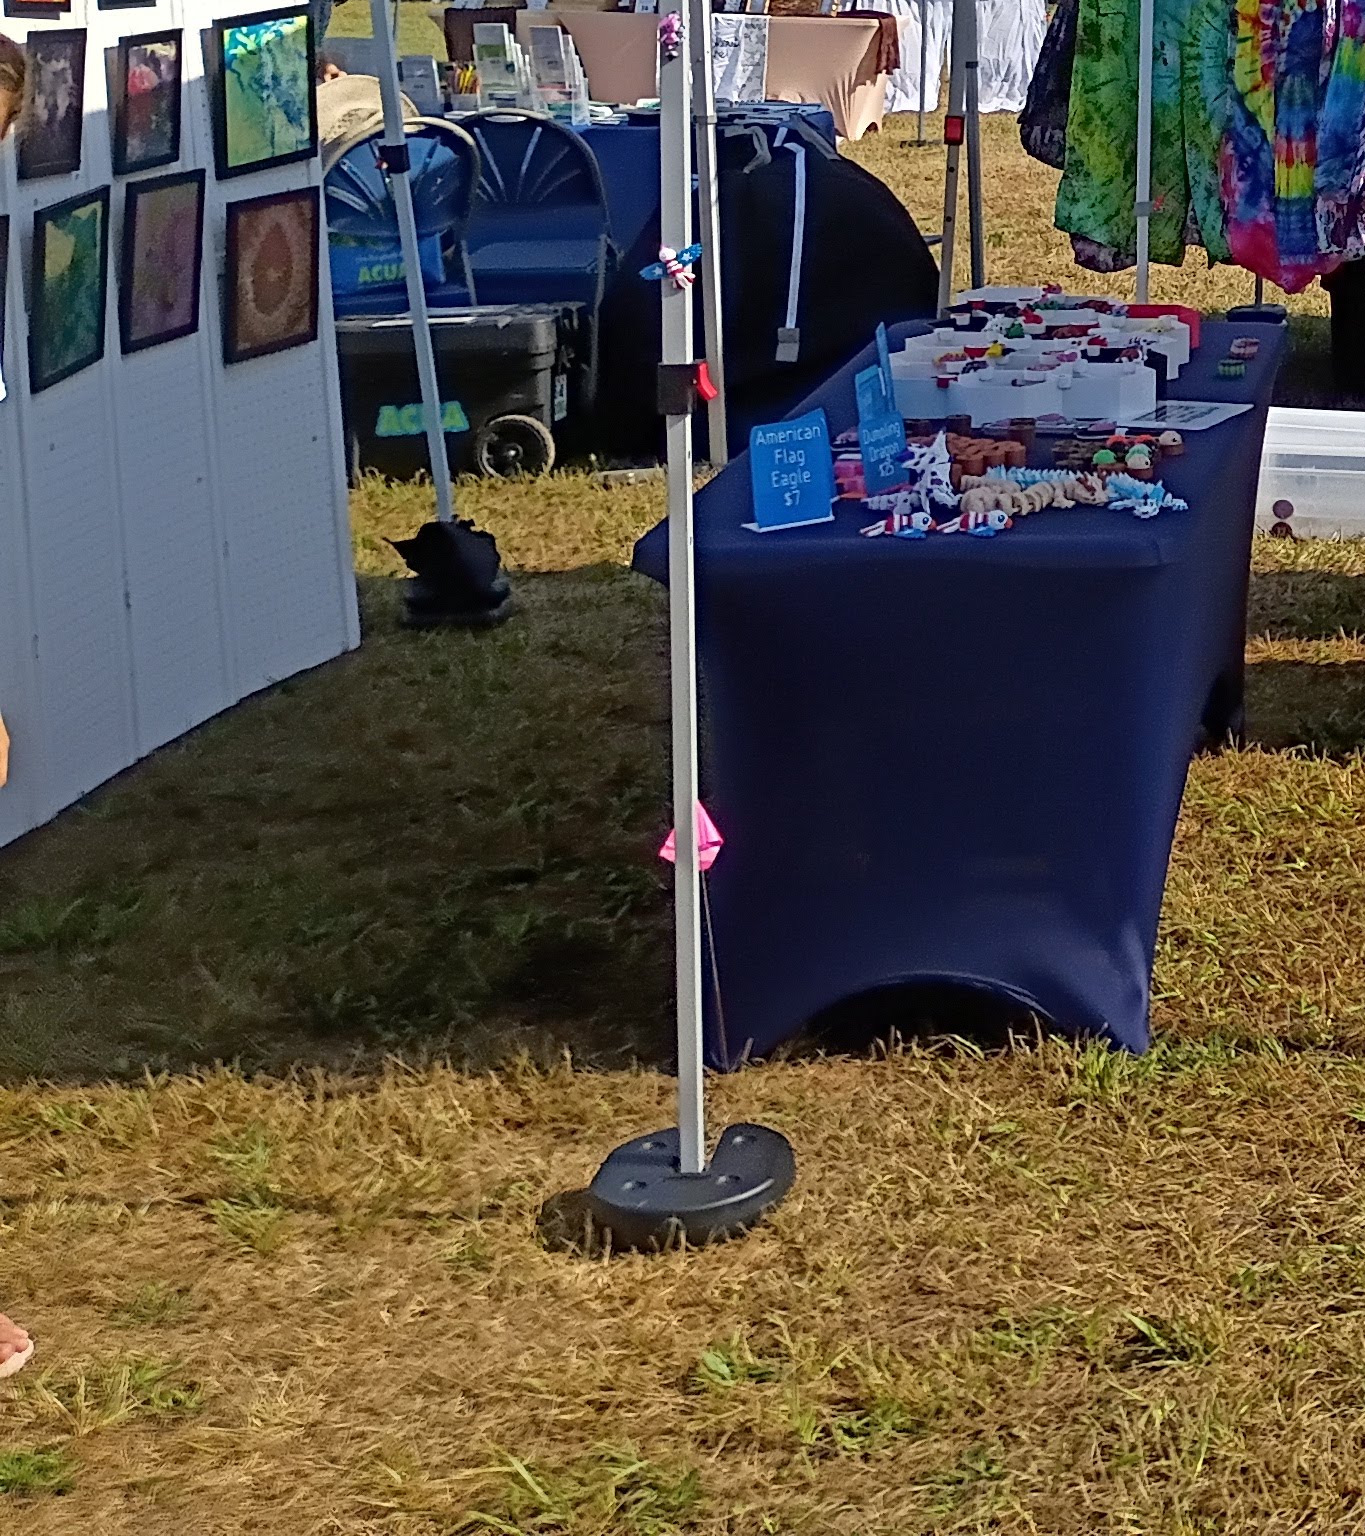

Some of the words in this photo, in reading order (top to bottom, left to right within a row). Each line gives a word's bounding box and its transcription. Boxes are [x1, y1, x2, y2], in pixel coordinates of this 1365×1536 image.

[379, 402, 468, 435] ACA
[756, 426, 821, 447] American
[862, 421, 901, 445] Dumpling
[774, 449, 806, 467] Flag
[868, 442, 900, 465] Dragon
[771, 470, 811, 489] Eagle
[784, 491, 800, 507] $7
